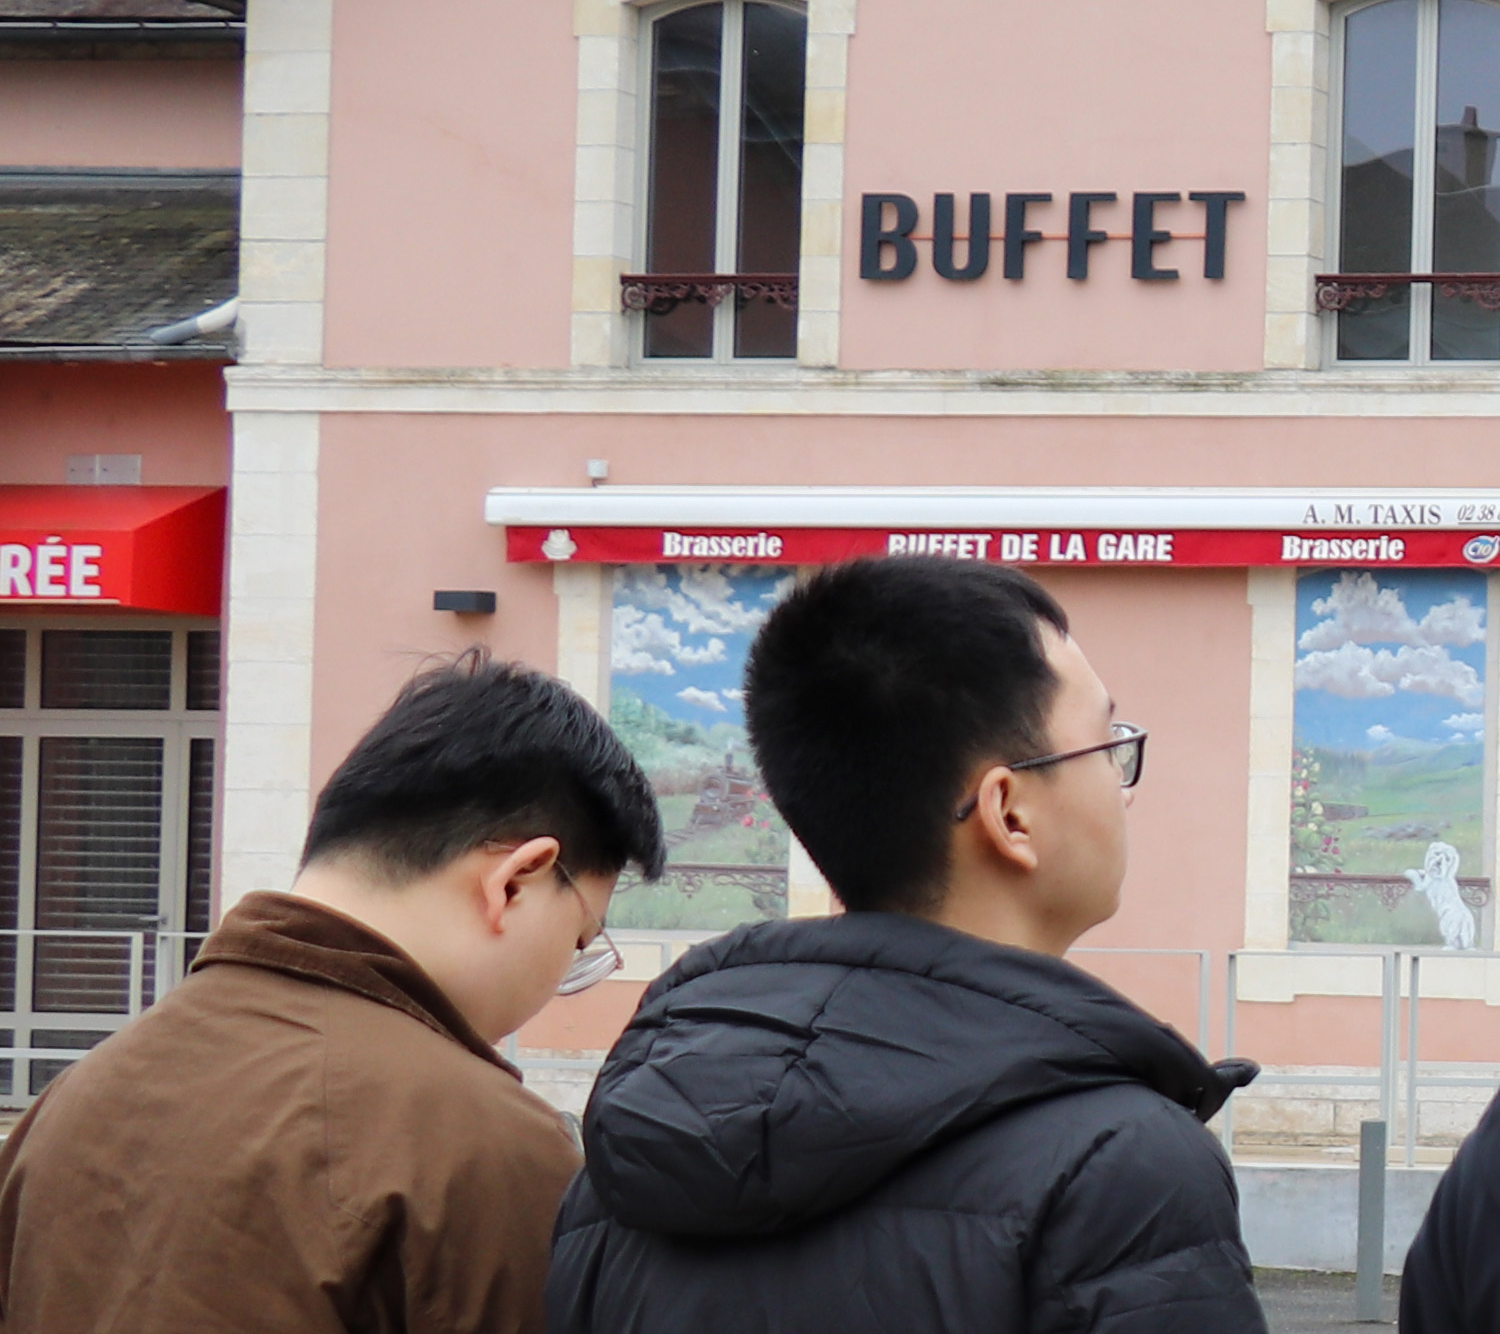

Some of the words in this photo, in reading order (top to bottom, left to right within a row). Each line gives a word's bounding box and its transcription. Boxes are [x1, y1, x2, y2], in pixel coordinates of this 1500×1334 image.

[859, 191, 1246, 282] BUFFET
[1302, 504, 1326, 525] A.
[1333, 504, 1361, 525] M.
[1368, 504, 1442, 525] TAXIS
[1457, 504, 1476, 521] 02
[662, 531, 783, 558] Brasserie
[888, 533, 993, 559] BUFFET
[1001, 533, 1039, 560] DE
[1050, 533, 1087, 560] LA
[1097, 533, 1174, 561] GARE
[1281, 534, 1405, 561] Brasserie
[0, 535, 102, 597] RÉE
